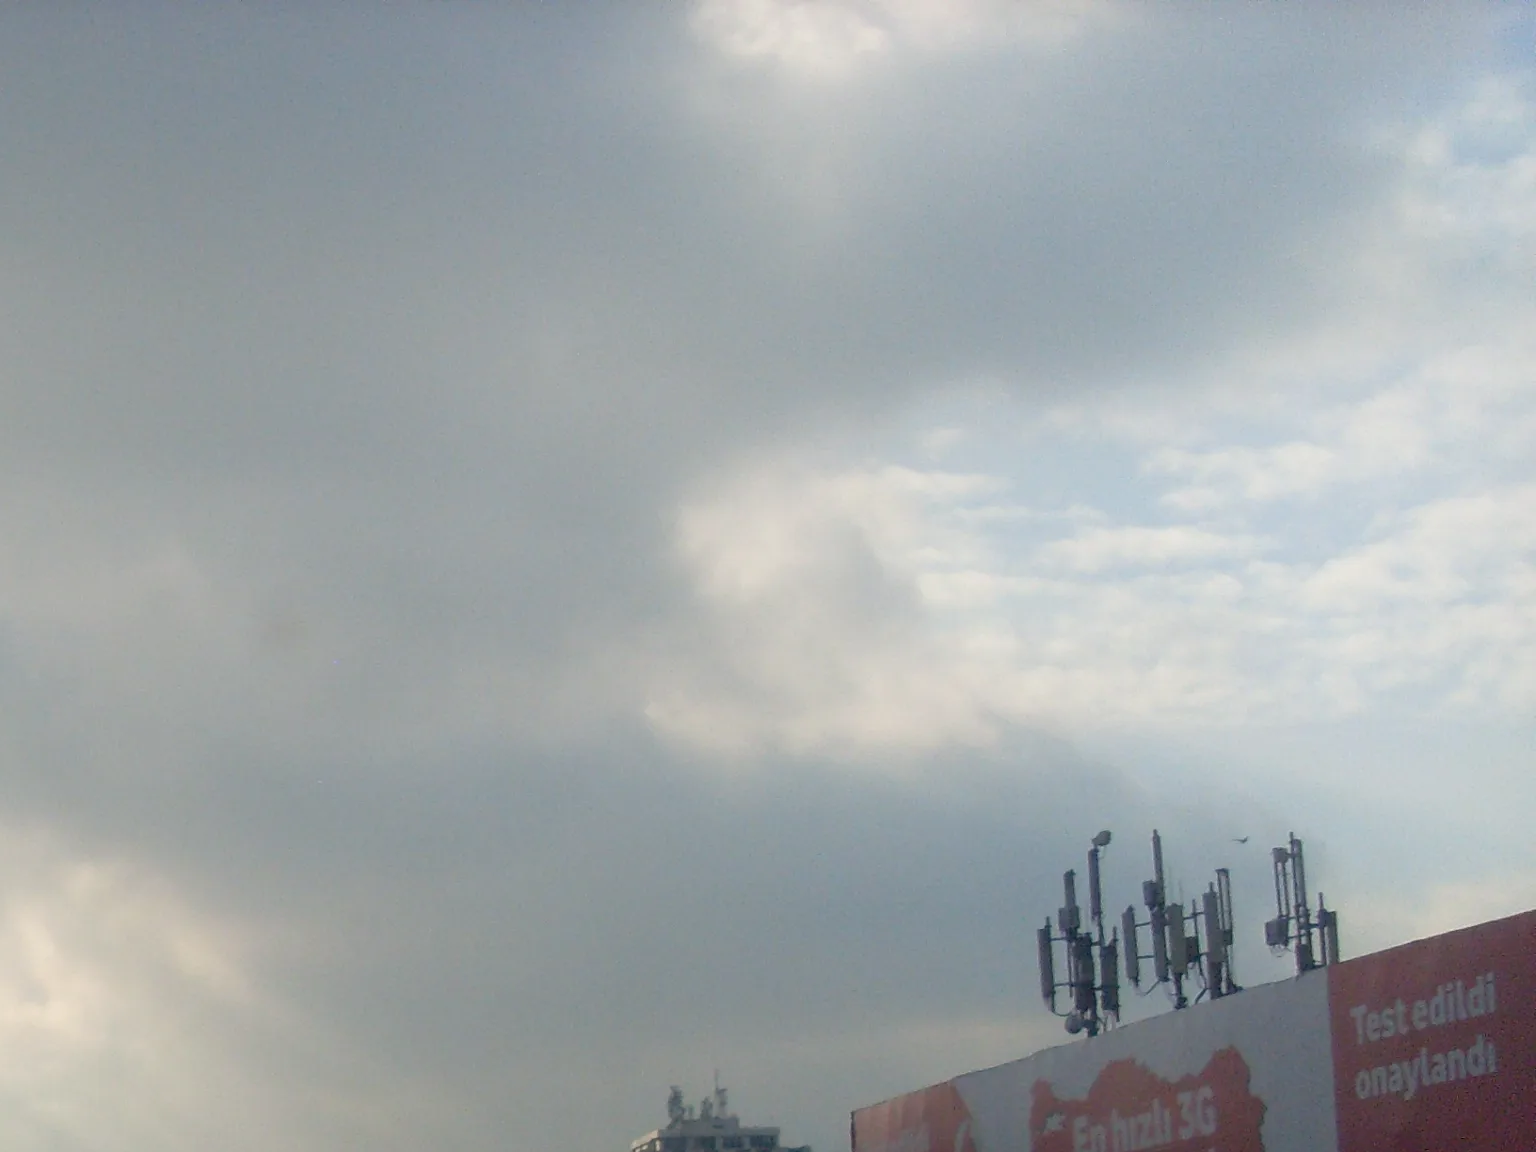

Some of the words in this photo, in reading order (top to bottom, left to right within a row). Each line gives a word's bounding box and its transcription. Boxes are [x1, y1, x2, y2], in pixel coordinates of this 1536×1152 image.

[1350, 997, 1409, 1044] Test
[1412, 971, 1496, 1030] edildi
[1355, 1034, 1497, 1100] onaylandı
[1177, 1085, 1217, 1140] 3G
